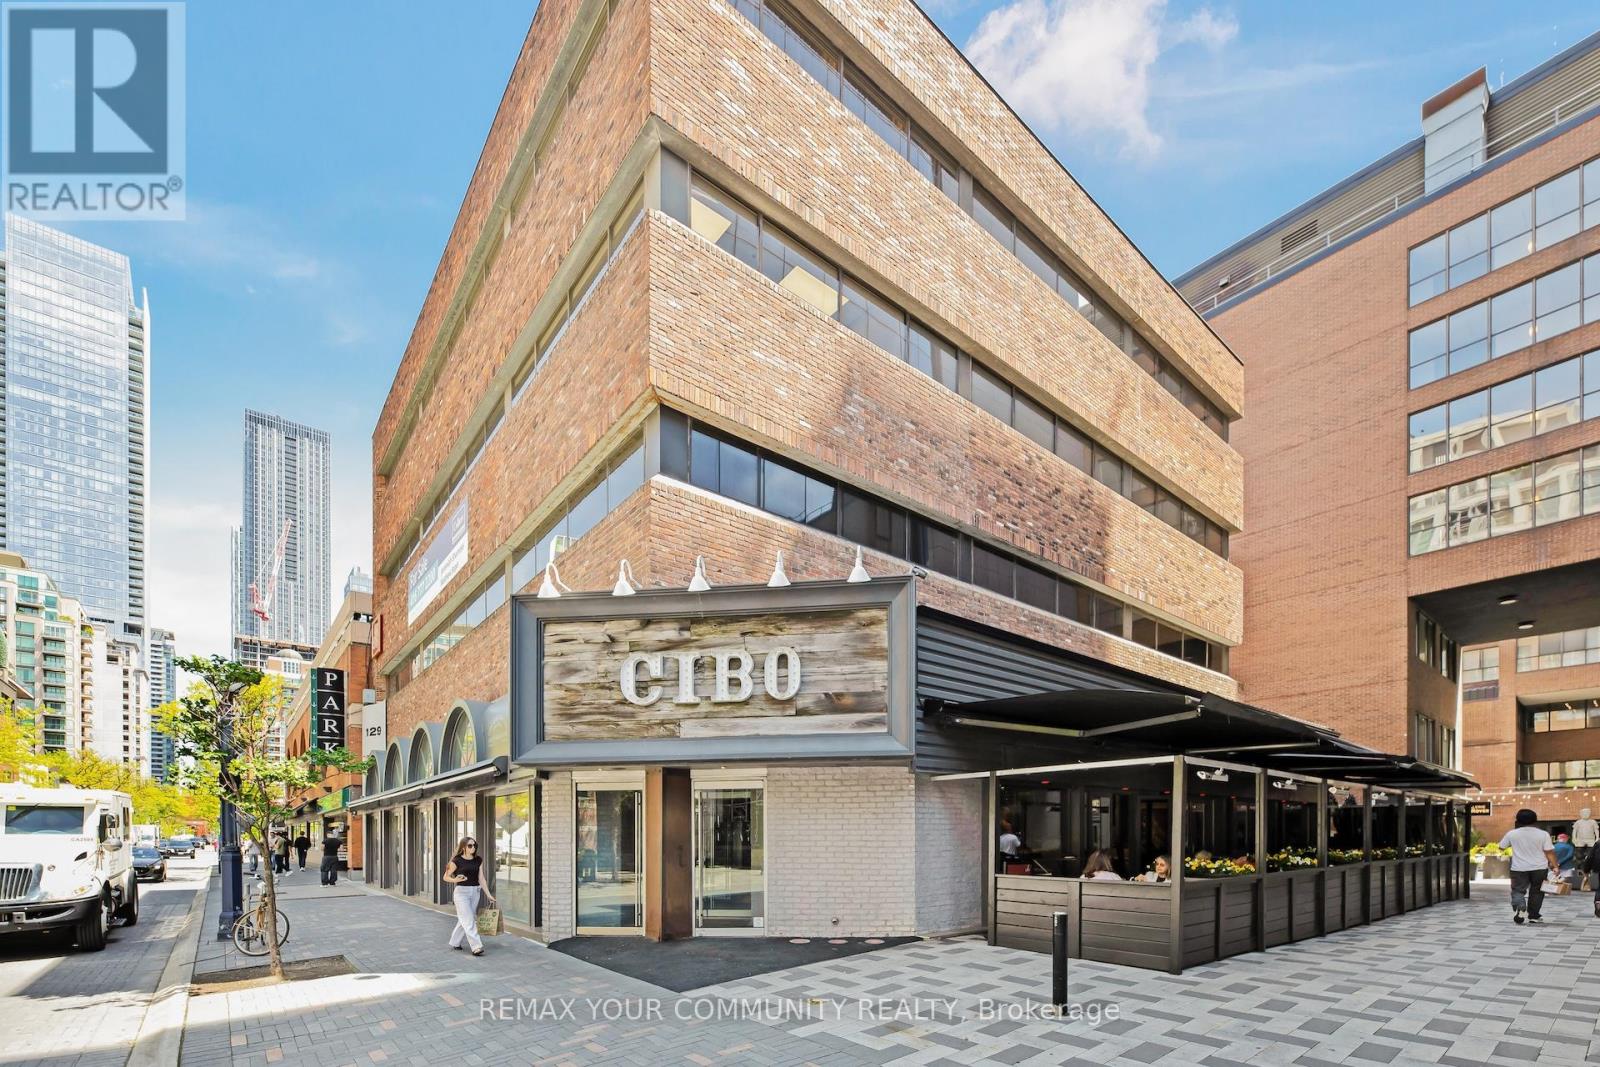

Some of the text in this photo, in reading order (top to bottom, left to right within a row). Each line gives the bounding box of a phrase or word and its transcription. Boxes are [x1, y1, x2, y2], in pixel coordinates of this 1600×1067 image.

[619, 646, 801, 706] CIBO
[322, 671, 340, 754] PARK
[366, 726, 382, 737] 129
